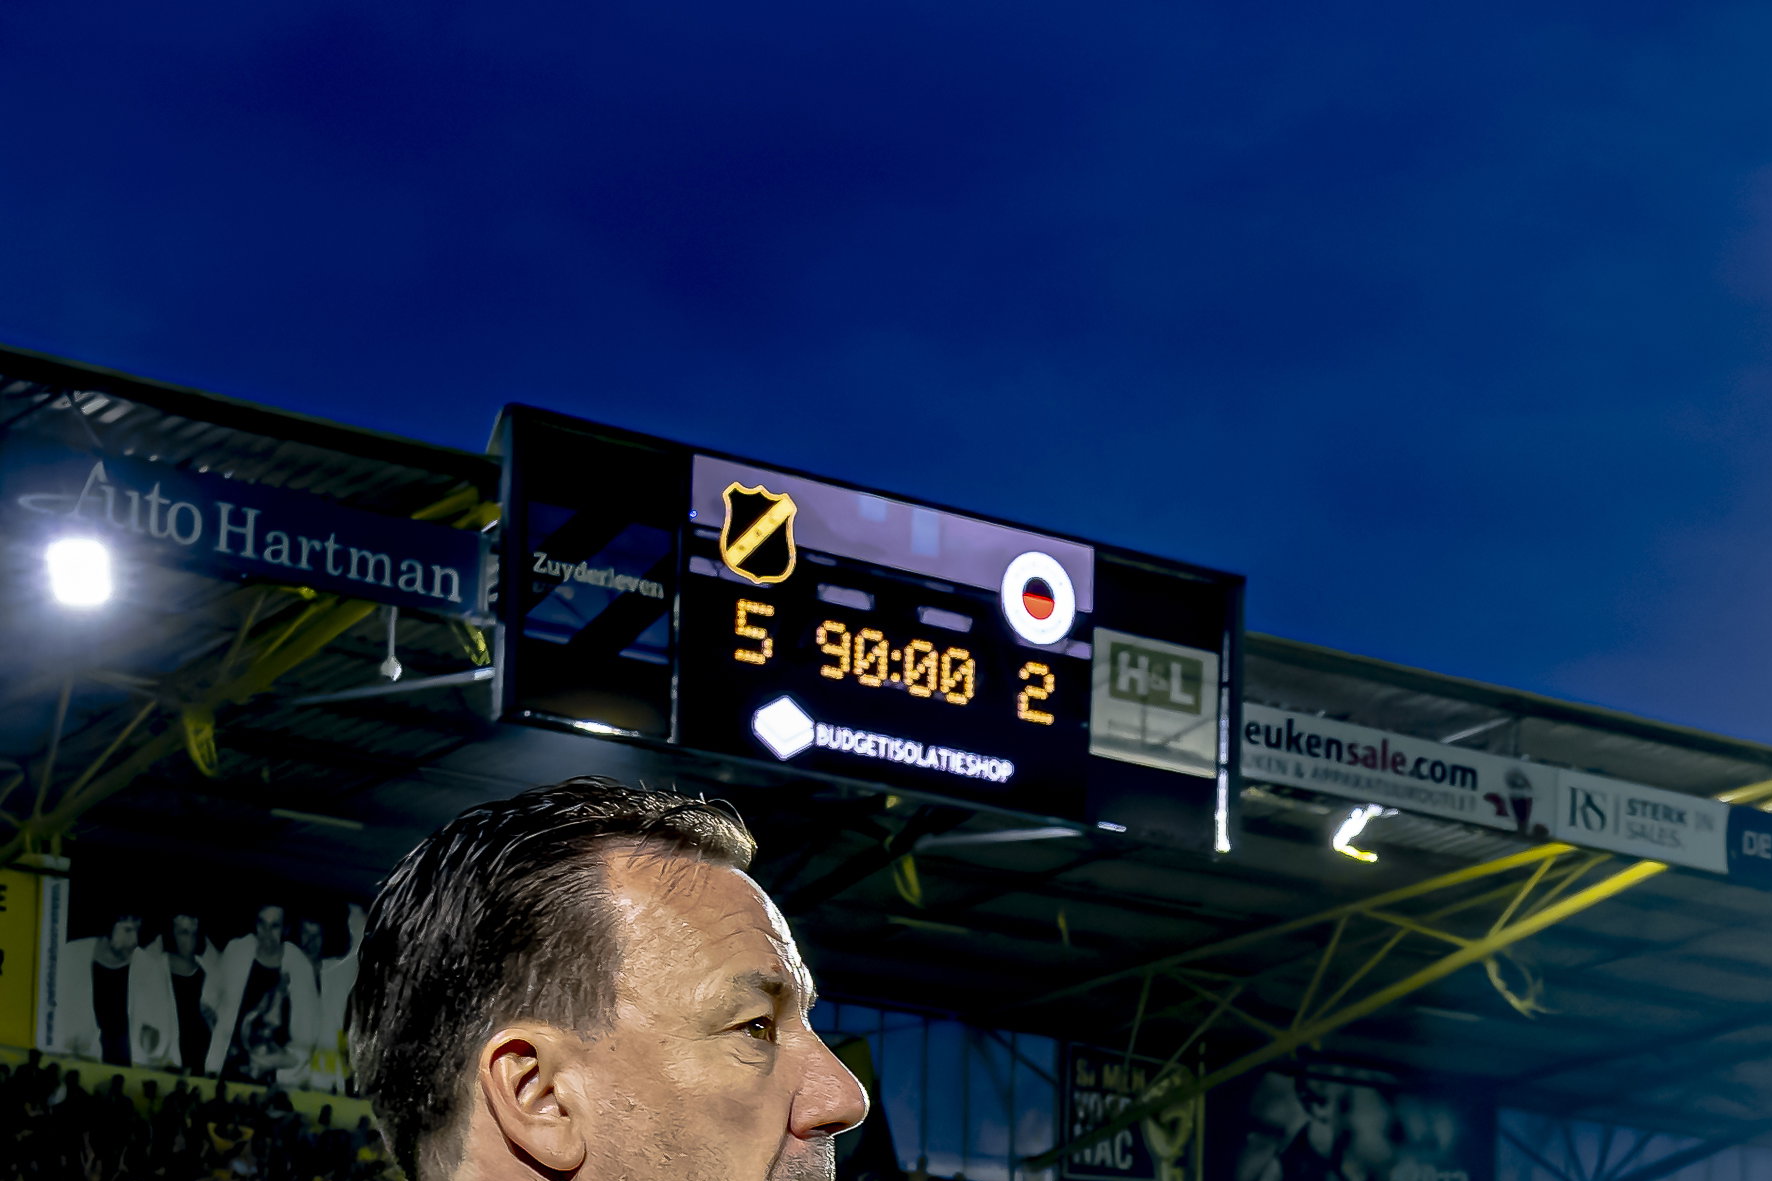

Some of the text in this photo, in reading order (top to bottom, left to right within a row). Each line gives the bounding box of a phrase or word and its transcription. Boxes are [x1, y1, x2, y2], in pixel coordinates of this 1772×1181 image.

[17, 459, 462, 604] Auto Hartman
[735, 598, 774, 665] 5
[816, 620, 975, 705] 90:00
[1017, 662, 1055, 725] 2
[814, 722, 1014, 783] BUDGETISOLATIESHOP
[1245, 718, 1478, 790] eukensale.com
[1627, 798, 1687, 824] STERK
[1742, 830, 1772, 860] DE
